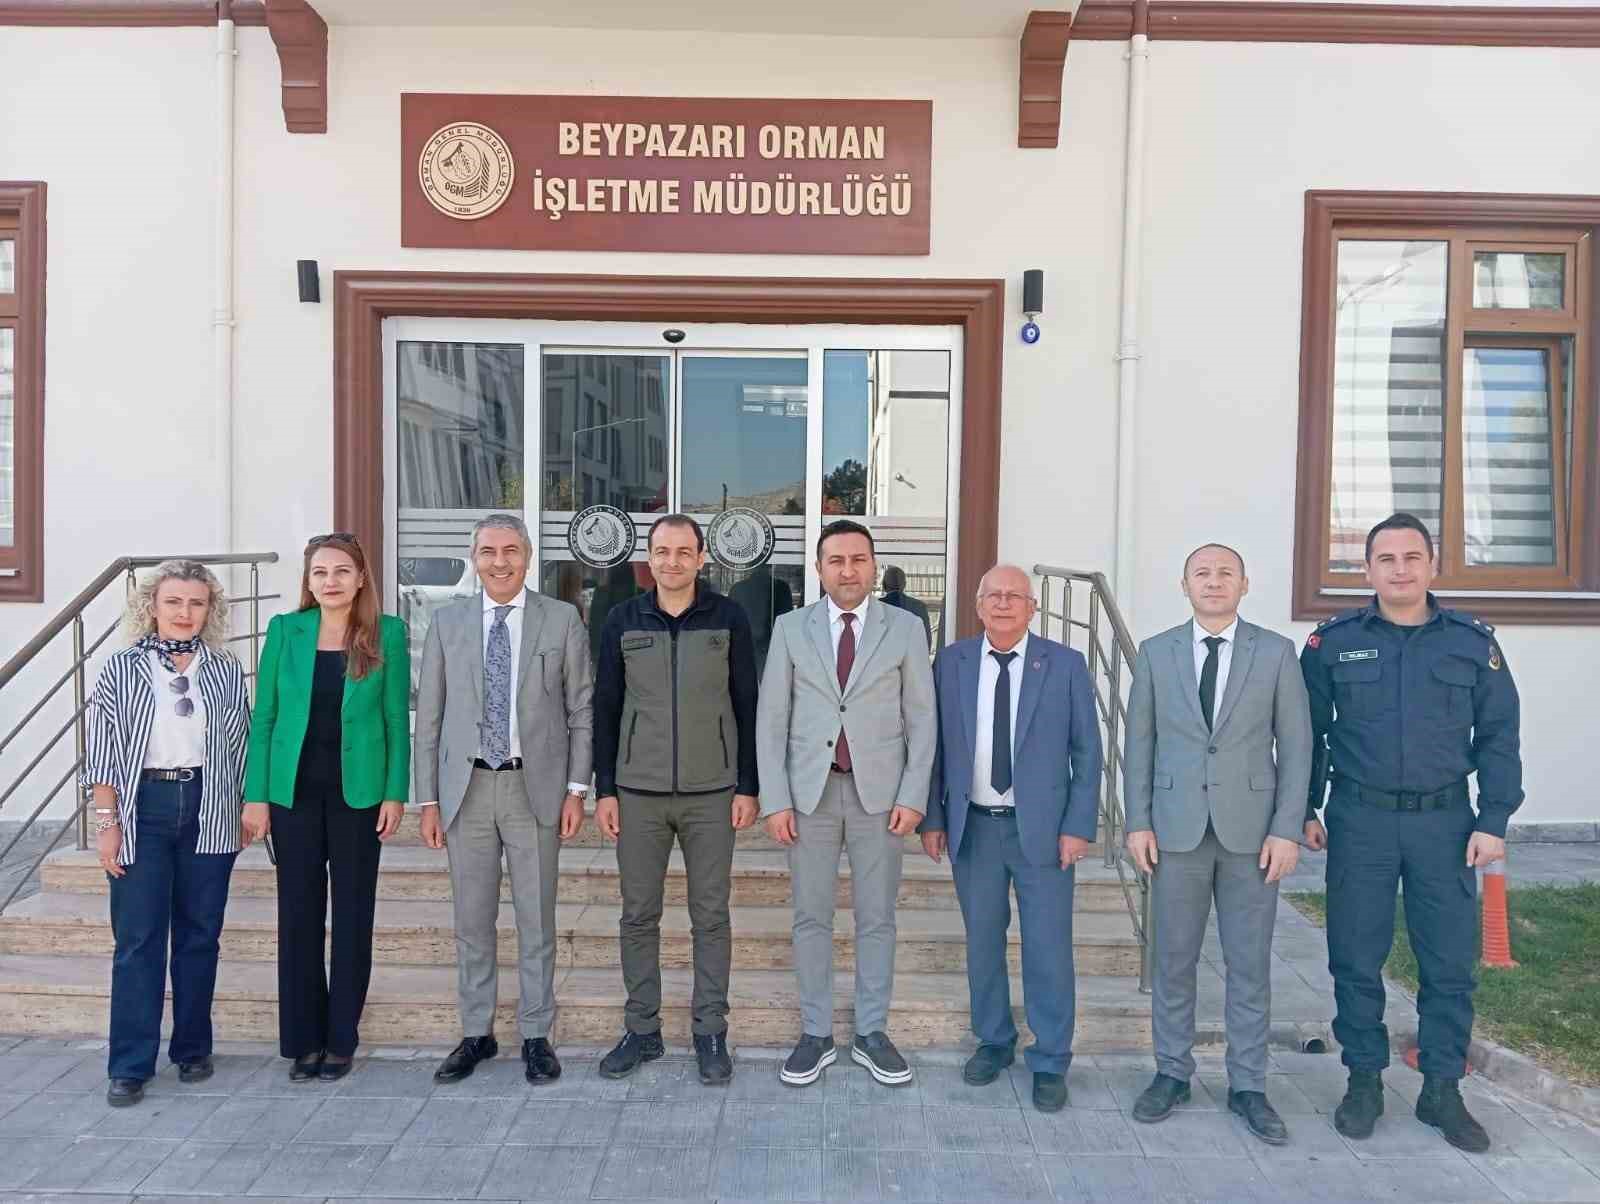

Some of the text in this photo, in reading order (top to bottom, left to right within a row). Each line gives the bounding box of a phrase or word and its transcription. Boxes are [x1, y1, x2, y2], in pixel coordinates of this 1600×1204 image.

[559, 122, 885, 159] BEYPAZARI ORMAN
[445, 182, 464, 197] OGM
[534, 169, 912, 220] İŞLETME MÜDÜRLÜĞÜ
